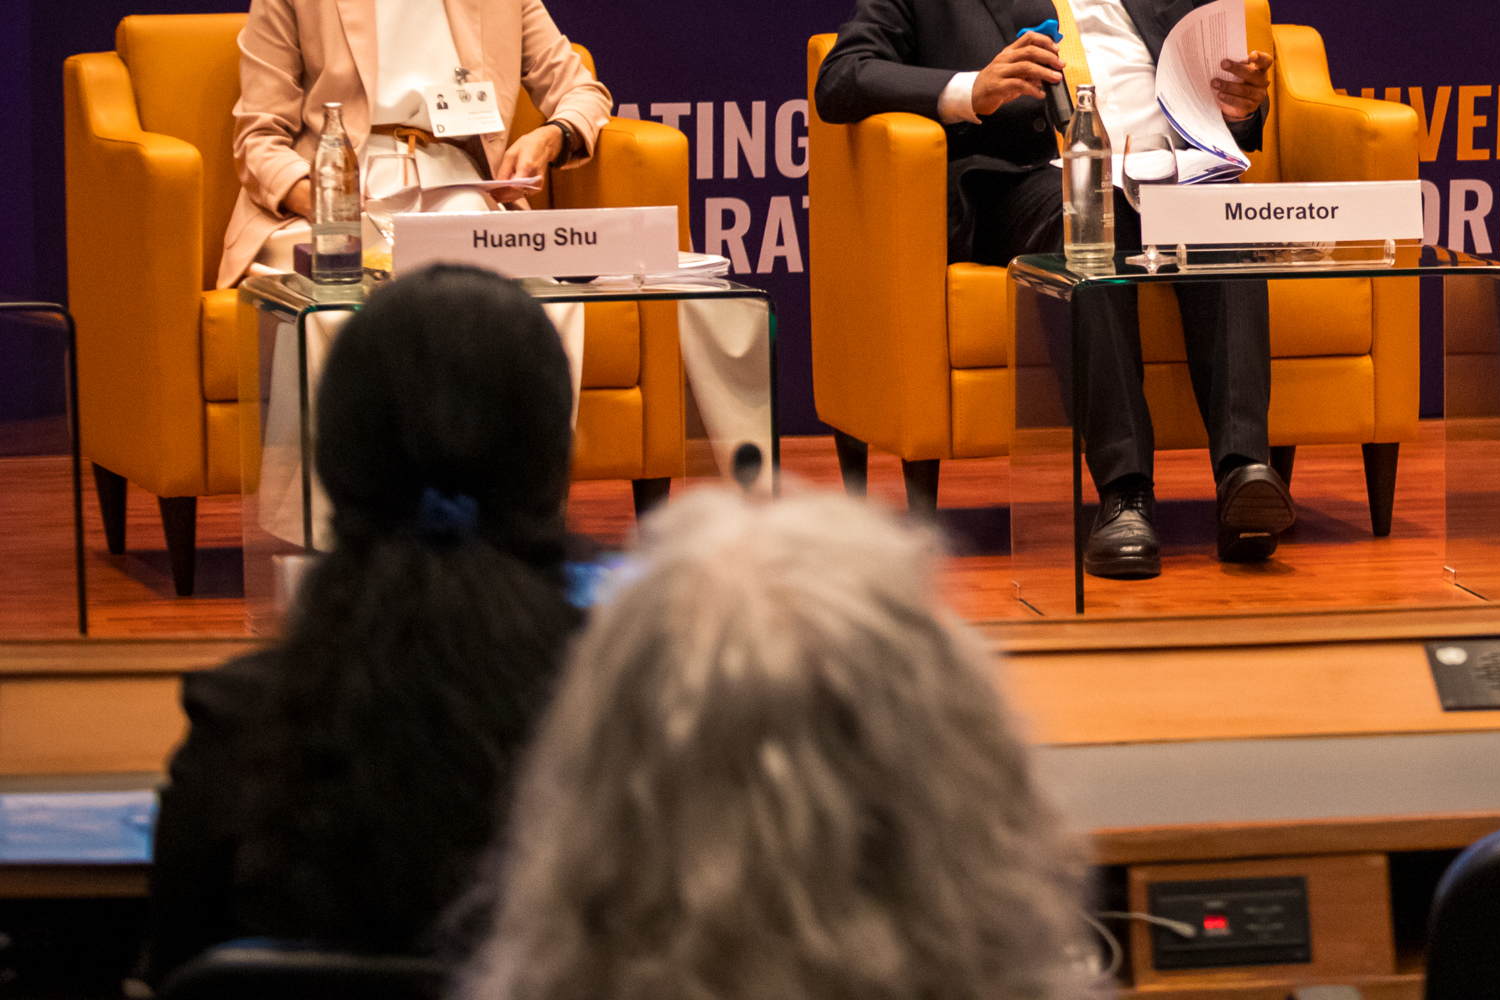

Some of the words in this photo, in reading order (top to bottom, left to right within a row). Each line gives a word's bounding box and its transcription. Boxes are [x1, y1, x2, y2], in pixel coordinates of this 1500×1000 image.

[436, 124, 445, 133] D
[616, 99, 809, 179] ING
[1225, 202, 1339, 220] Moderator
[473, 229, 545, 251] Huang
[554, 227, 597, 246] Shu
[689, 196, 809, 274] RA
